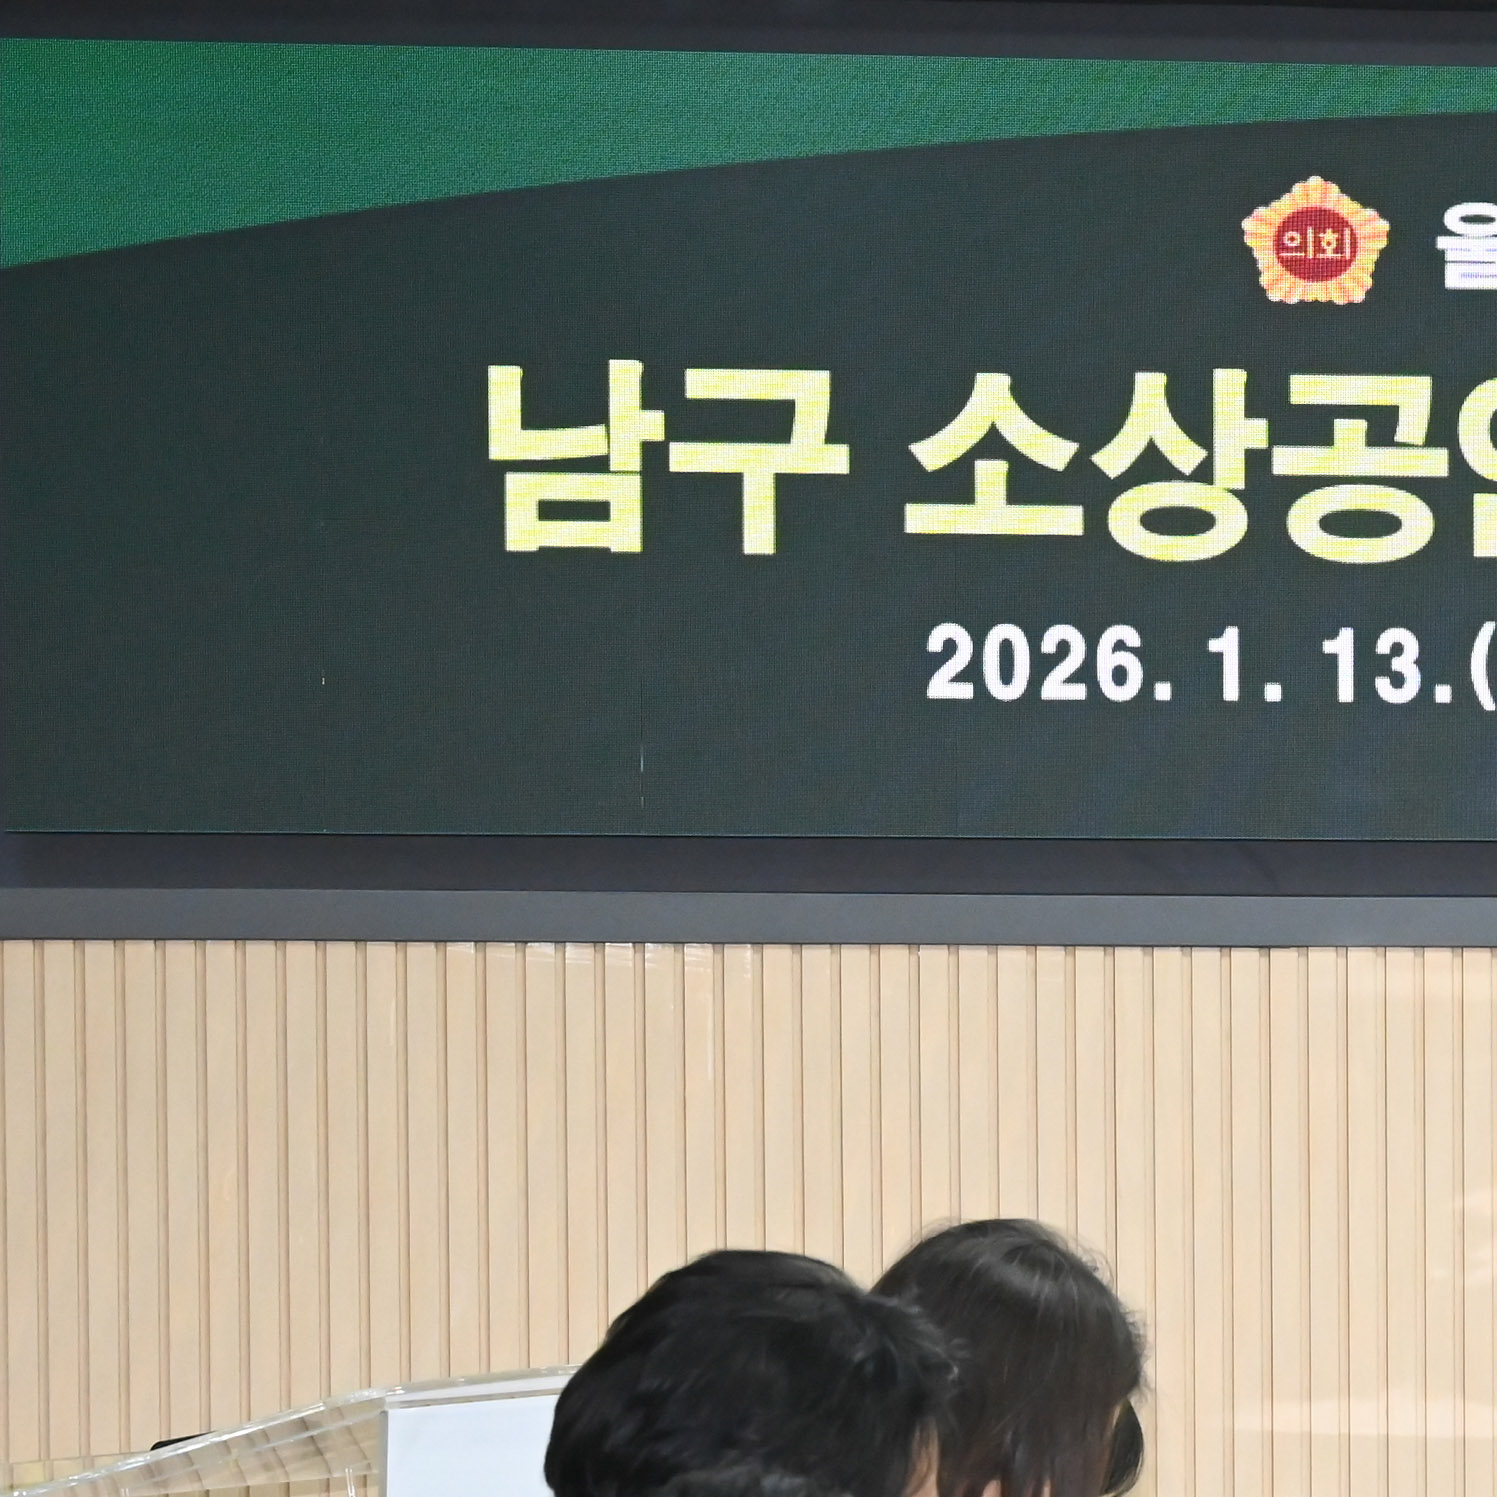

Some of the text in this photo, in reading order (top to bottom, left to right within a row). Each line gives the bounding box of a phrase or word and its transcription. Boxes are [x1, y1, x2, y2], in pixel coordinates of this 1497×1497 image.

[1279, 225, 1350, 260] 의회
[487, 359, 850, 556] 남구
[926, 622, 1173, 703] 2026.
[1208, 625, 1282, 703] 1.
